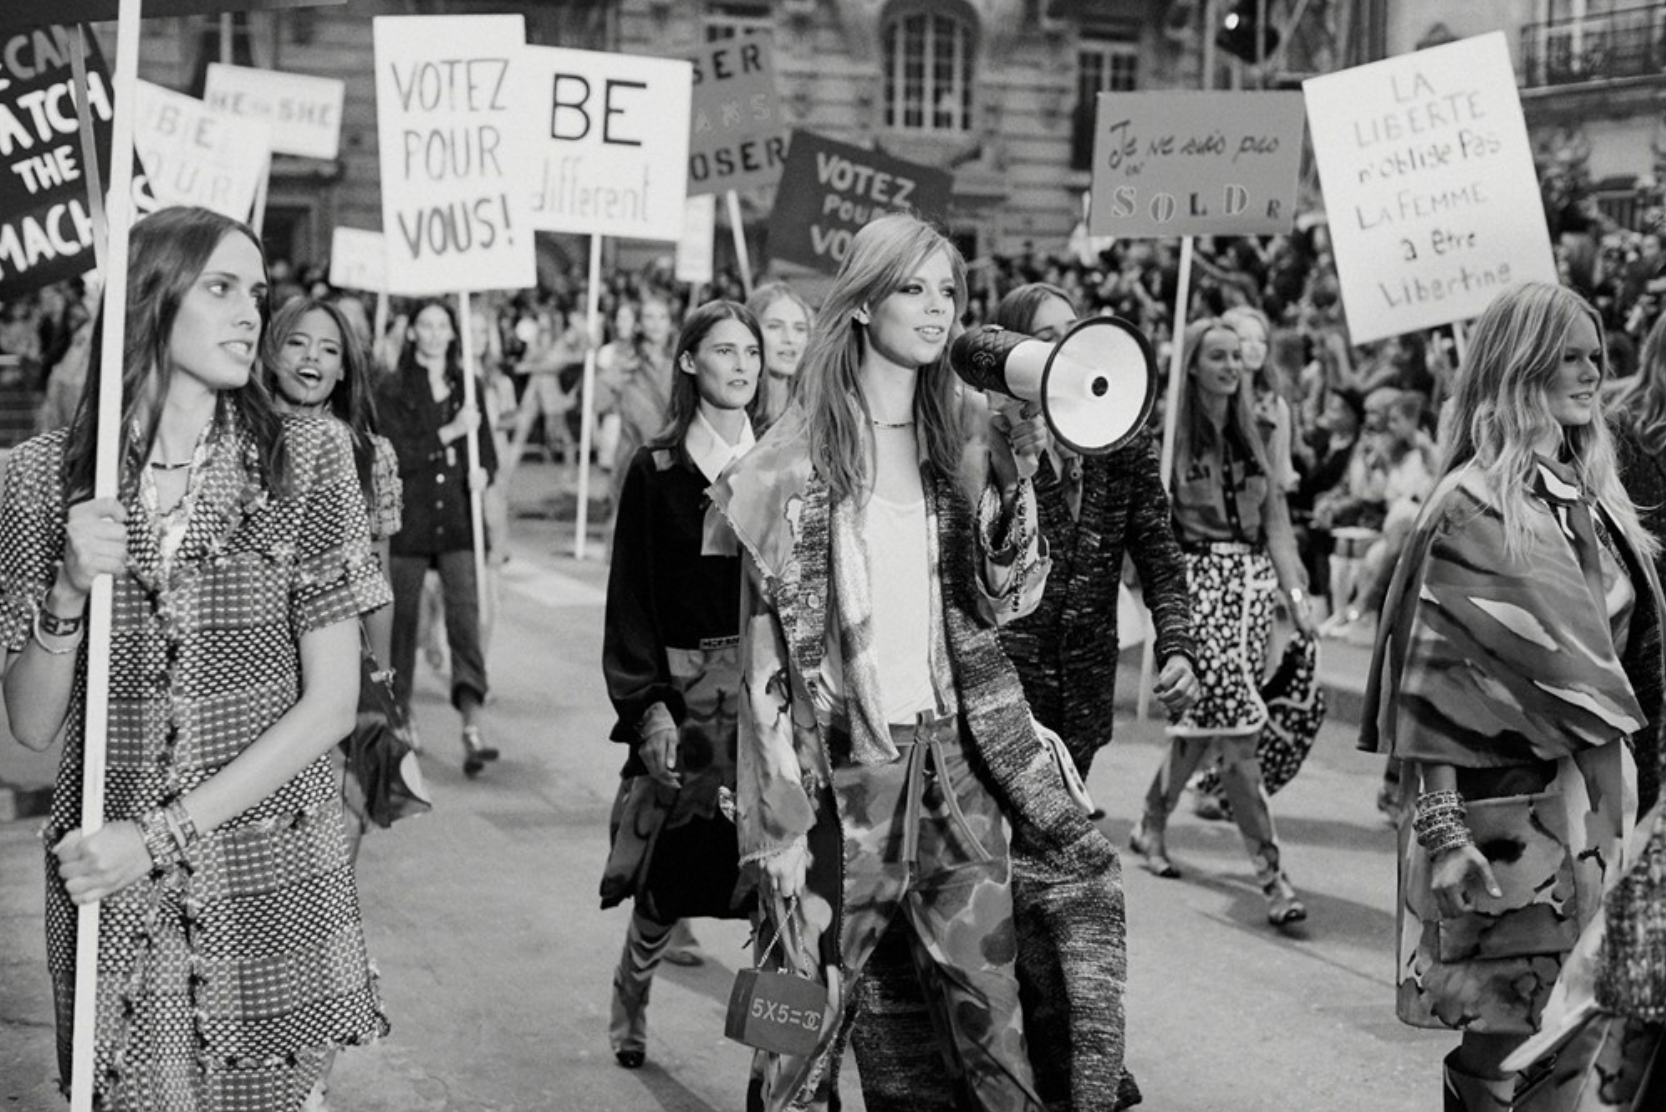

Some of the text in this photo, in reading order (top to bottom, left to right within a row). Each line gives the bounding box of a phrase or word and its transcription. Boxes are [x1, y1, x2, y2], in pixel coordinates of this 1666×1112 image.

[391, 58, 511, 113] VOTEZ
[549, 71, 649, 148] BE
[1391, 71, 1437, 104] LA
[156, 104, 216, 151] BE
[277, 97, 334, 128] SHE
[11, 145, 81, 194] THE
[403, 124, 504, 181] POUR
[816, 151, 916, 209] VOTEZ
[1397, 182, 1490, 220] FEMME
[397, 192, 515, 261] VOUS!
[1377, 261, 1511, 308] Libertine
